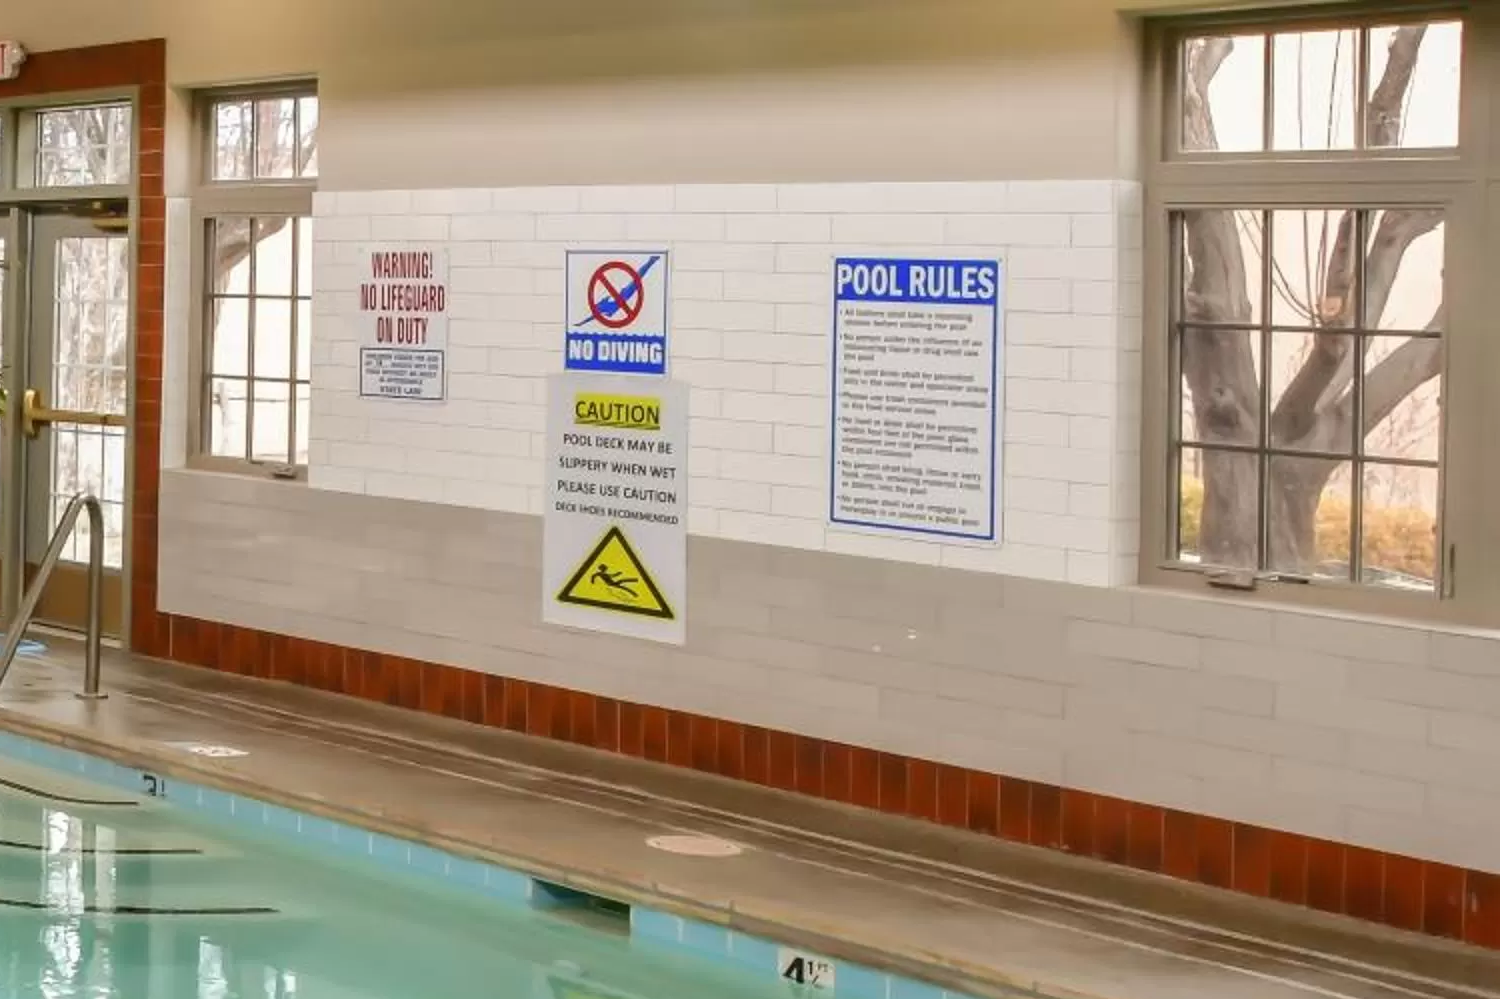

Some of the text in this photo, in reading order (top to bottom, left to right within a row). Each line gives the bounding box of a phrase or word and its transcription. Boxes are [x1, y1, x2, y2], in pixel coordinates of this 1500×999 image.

[371, 251, 433, 279] WARNING!
[837, 263, 996, 300] POOL RULES
[361, 284, 445, 312] NO LIFEGUARD
[377, 317, 429, 345] ON DUTY
[569, 339, 663, 365] NO DIVING
[575, 401, 660, 424] CAUTION
[563, 433, 674, 455] POOL DECK MAY BE
[559, 456, 677, 480] SLIPPERY WHEN WET
[557, 480, 677, 504] PLEASE USE CAUTION
